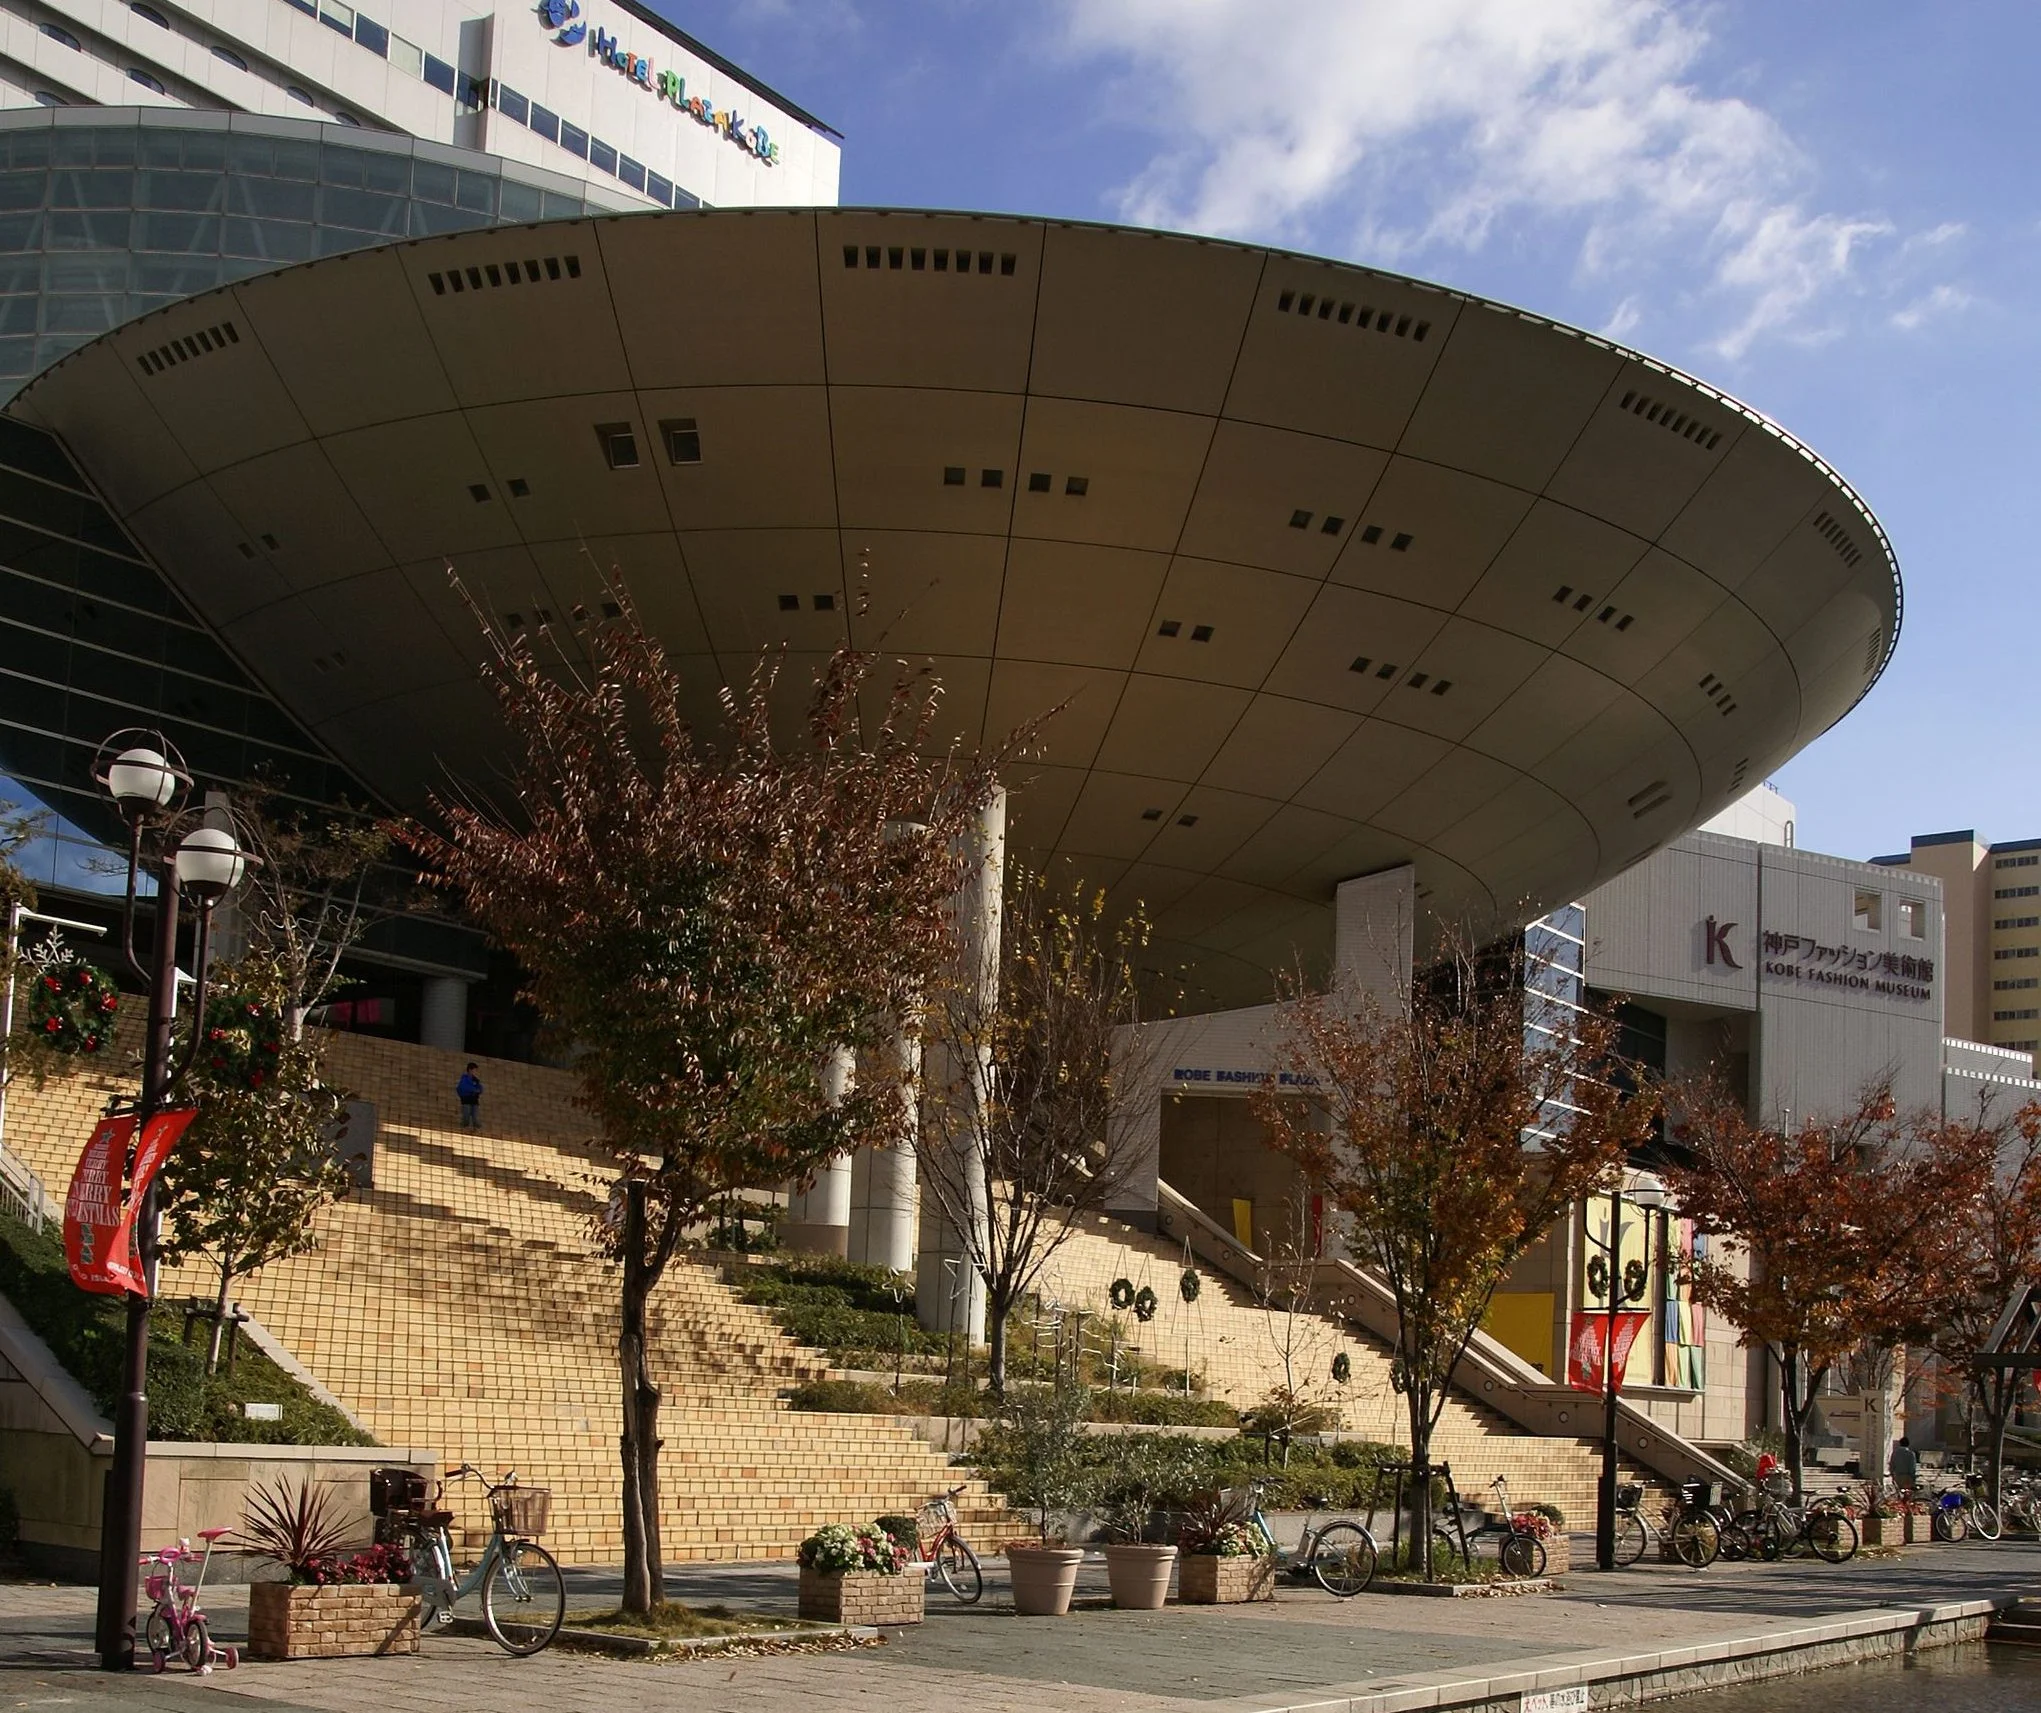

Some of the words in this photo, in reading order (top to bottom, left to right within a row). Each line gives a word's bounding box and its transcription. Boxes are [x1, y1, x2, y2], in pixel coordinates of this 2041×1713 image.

[1763, 930, 1935, 983] 神戸ファッション美術館
[1766, 961, 1802, 980] KOBE
[1808, 969, 1870, 990] FASHION
[1875, 980, 1932, 1001] MUSEUM
[1174, 1068, 1212, 1082] KOBE
[1216, 1070, 1274, 1084] FASHI
[1864, 1397, 1881, 1413] K
